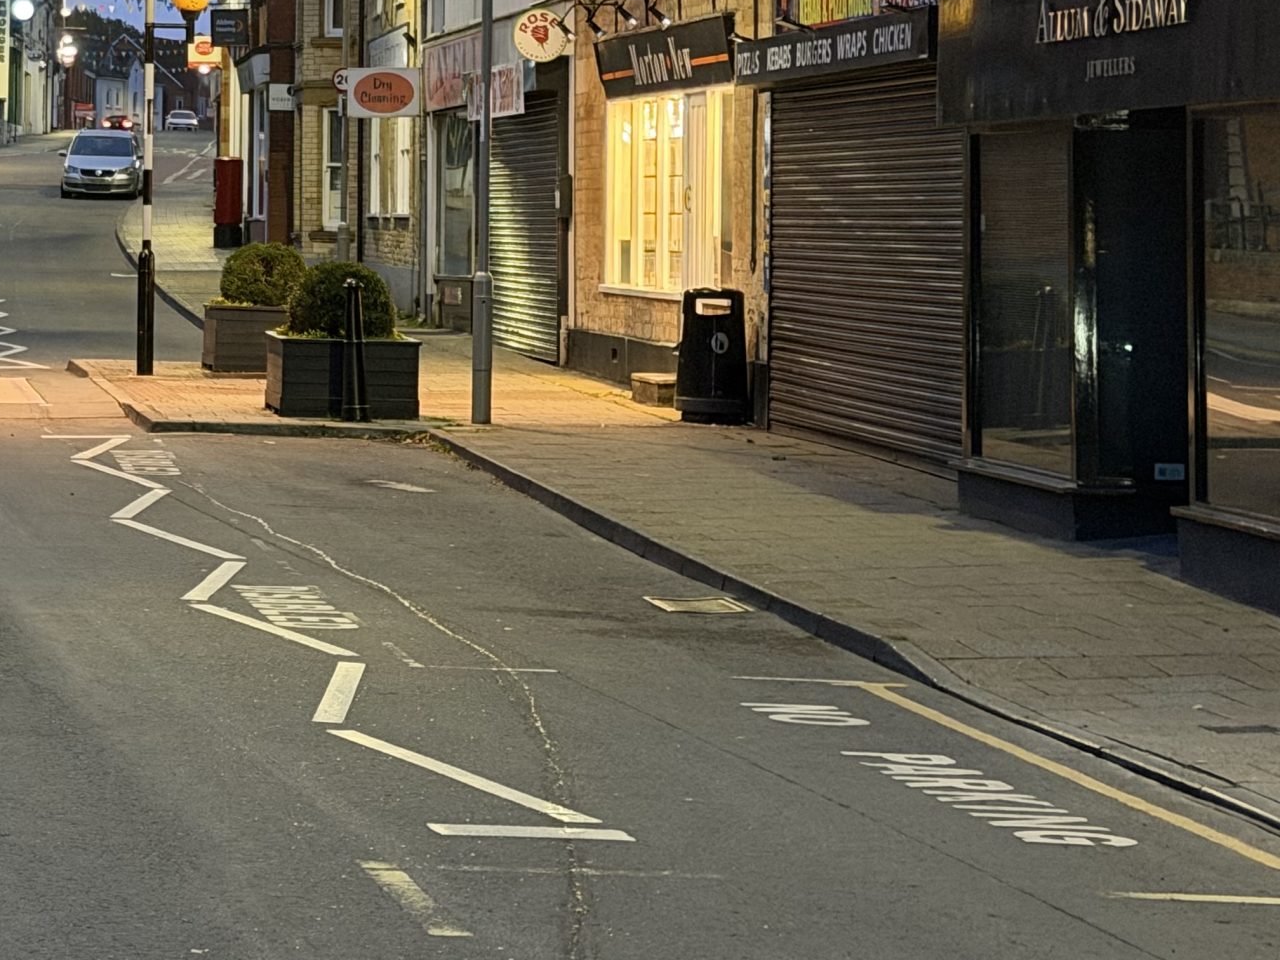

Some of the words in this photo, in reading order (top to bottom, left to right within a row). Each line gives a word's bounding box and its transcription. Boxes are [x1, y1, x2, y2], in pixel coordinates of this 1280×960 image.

[518, 12, 560, 34] ROSE
[628, 43, 669, 86] Morton
[668, 36, 693, 81] New
[737, 50, 760, 76] PIZZAS
[766, 44, 792, 72] KEBABS
[796, 39, 832, 67] BURGERS
[837, 30, 868, 60] WRAPS
[873, 22, 912, 55] CHICKEN
[336, 74, 348, 85] 2
[1085, 56, 1136, 82] JEWELLERS
[373, 77, 392, 92] Dry
[360, 91, 407, 106] Cleaning
[229, 584, 360, 630] DISABLED
[739, 702, 871, 726] NO
[839, 750, 1139, 847] PARKING
